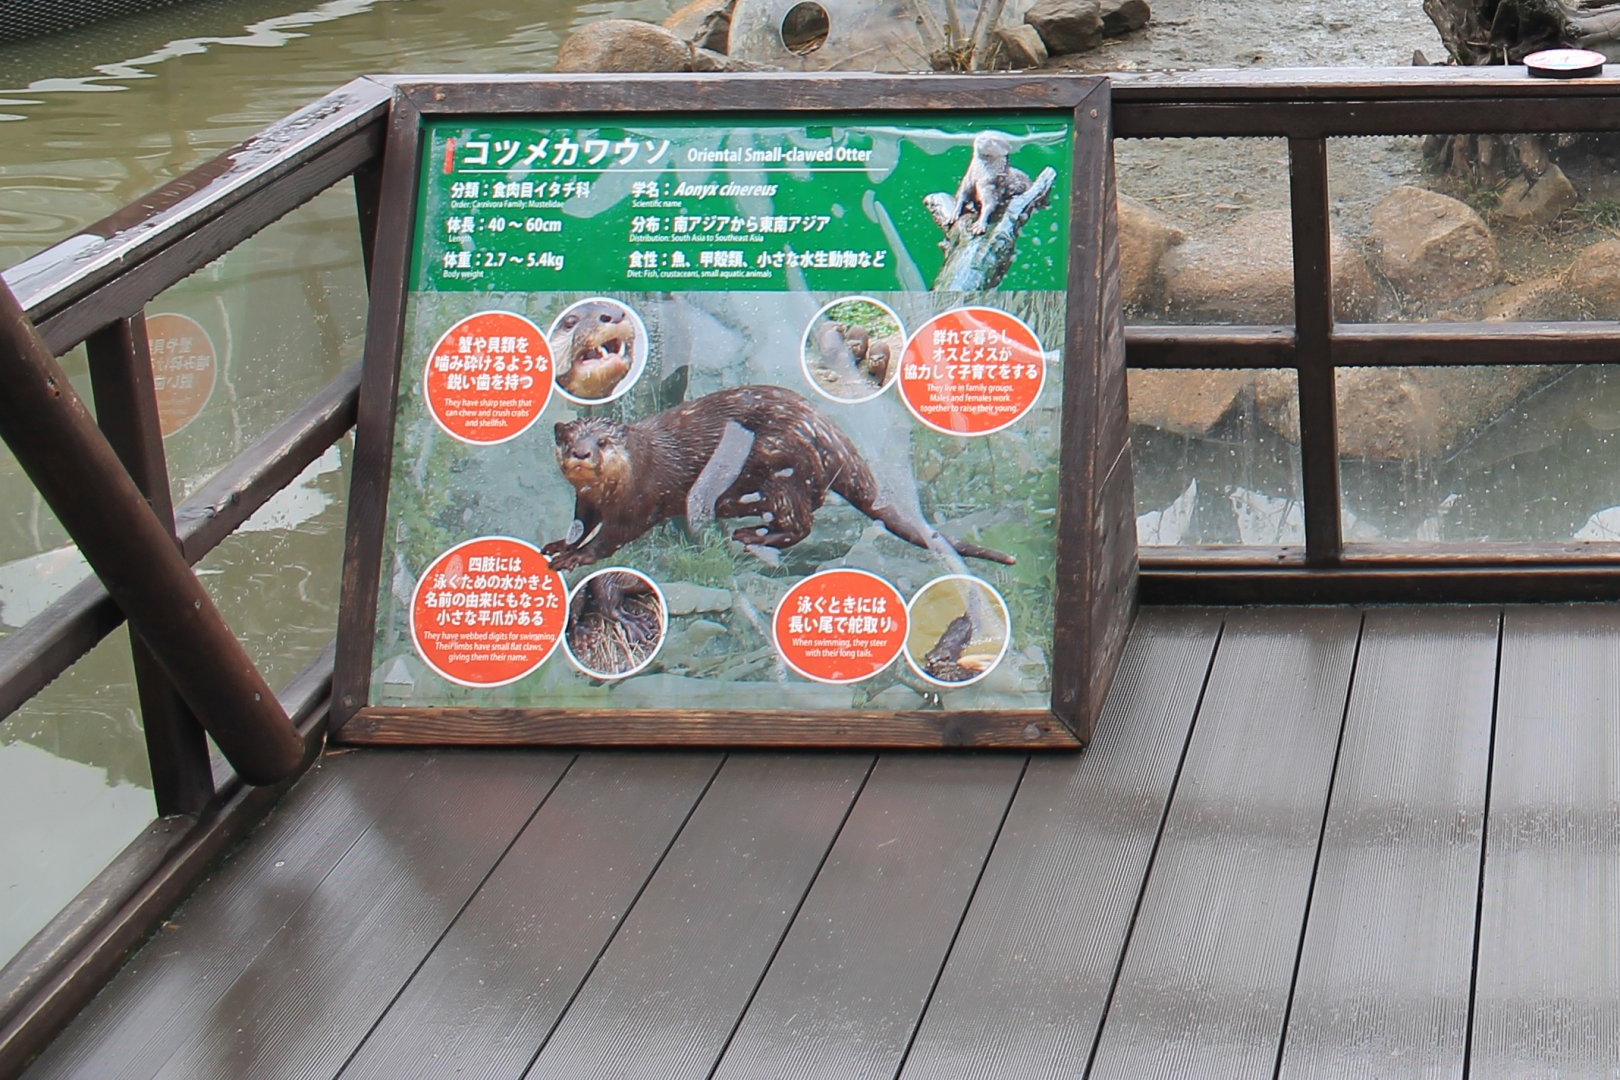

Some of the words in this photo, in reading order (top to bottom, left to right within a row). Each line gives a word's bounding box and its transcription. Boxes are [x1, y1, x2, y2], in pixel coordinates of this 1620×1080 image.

[463, 137, 671, 166] コツメカワウソ
[687, 147, 742, 163] Oriental
[745, 147, 833, 163] Small-clawed
[836, 147, 873, 163] Otter
[719, 181, 779, 197] cinereus
[631, 216, 831, 233] 分布：南アジアから東南アジア
[671, 234, 691, 242] South
[691, 234, 705, 242] Asia
[714, 234, 748, 242] Southeast
[749, 234, 764, 242] Asia
[932, 347, 1013, 361] オスとメスが
[904, 364, 1038, 380] 協力して子育てをする
[468, 556, 521, 573] 四肢には
[433, 574, 553, 591] 泳ぐための水かきと
[424, 592, 559, 609] 名前の由来にもなった
[797, 595, 887, 614] 泳ぐときには
[436, 610, 544, 626] 小さな平爪がある
[788, 615, 892, 634] 長い尾で舵取り
[424, 631, 441, 641] They
[441, 631, 459, 640] have
[792, 638, 813, 647] When
[852, 638, 869, 648] they
[473, 641, 490, 650] have
